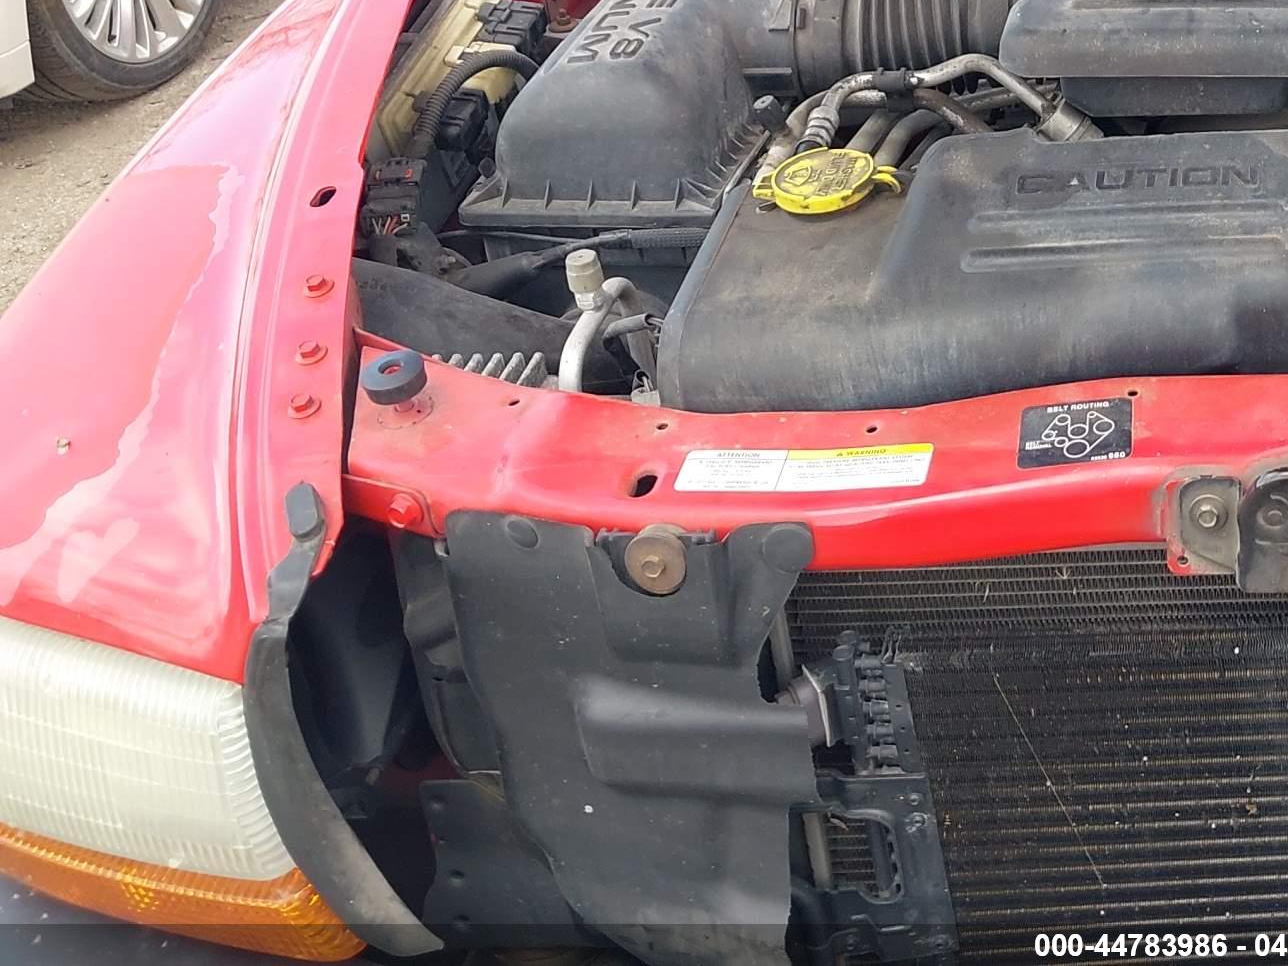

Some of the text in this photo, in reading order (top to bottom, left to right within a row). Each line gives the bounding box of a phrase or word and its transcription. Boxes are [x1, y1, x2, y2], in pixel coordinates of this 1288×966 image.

[609, 17, 662, 60] V8
[1015, 163, 1261, 195] CAUTION
[1046, 401, 1110, 413] BELT ROUTING
[846, 448, 887, 456] WARNING
